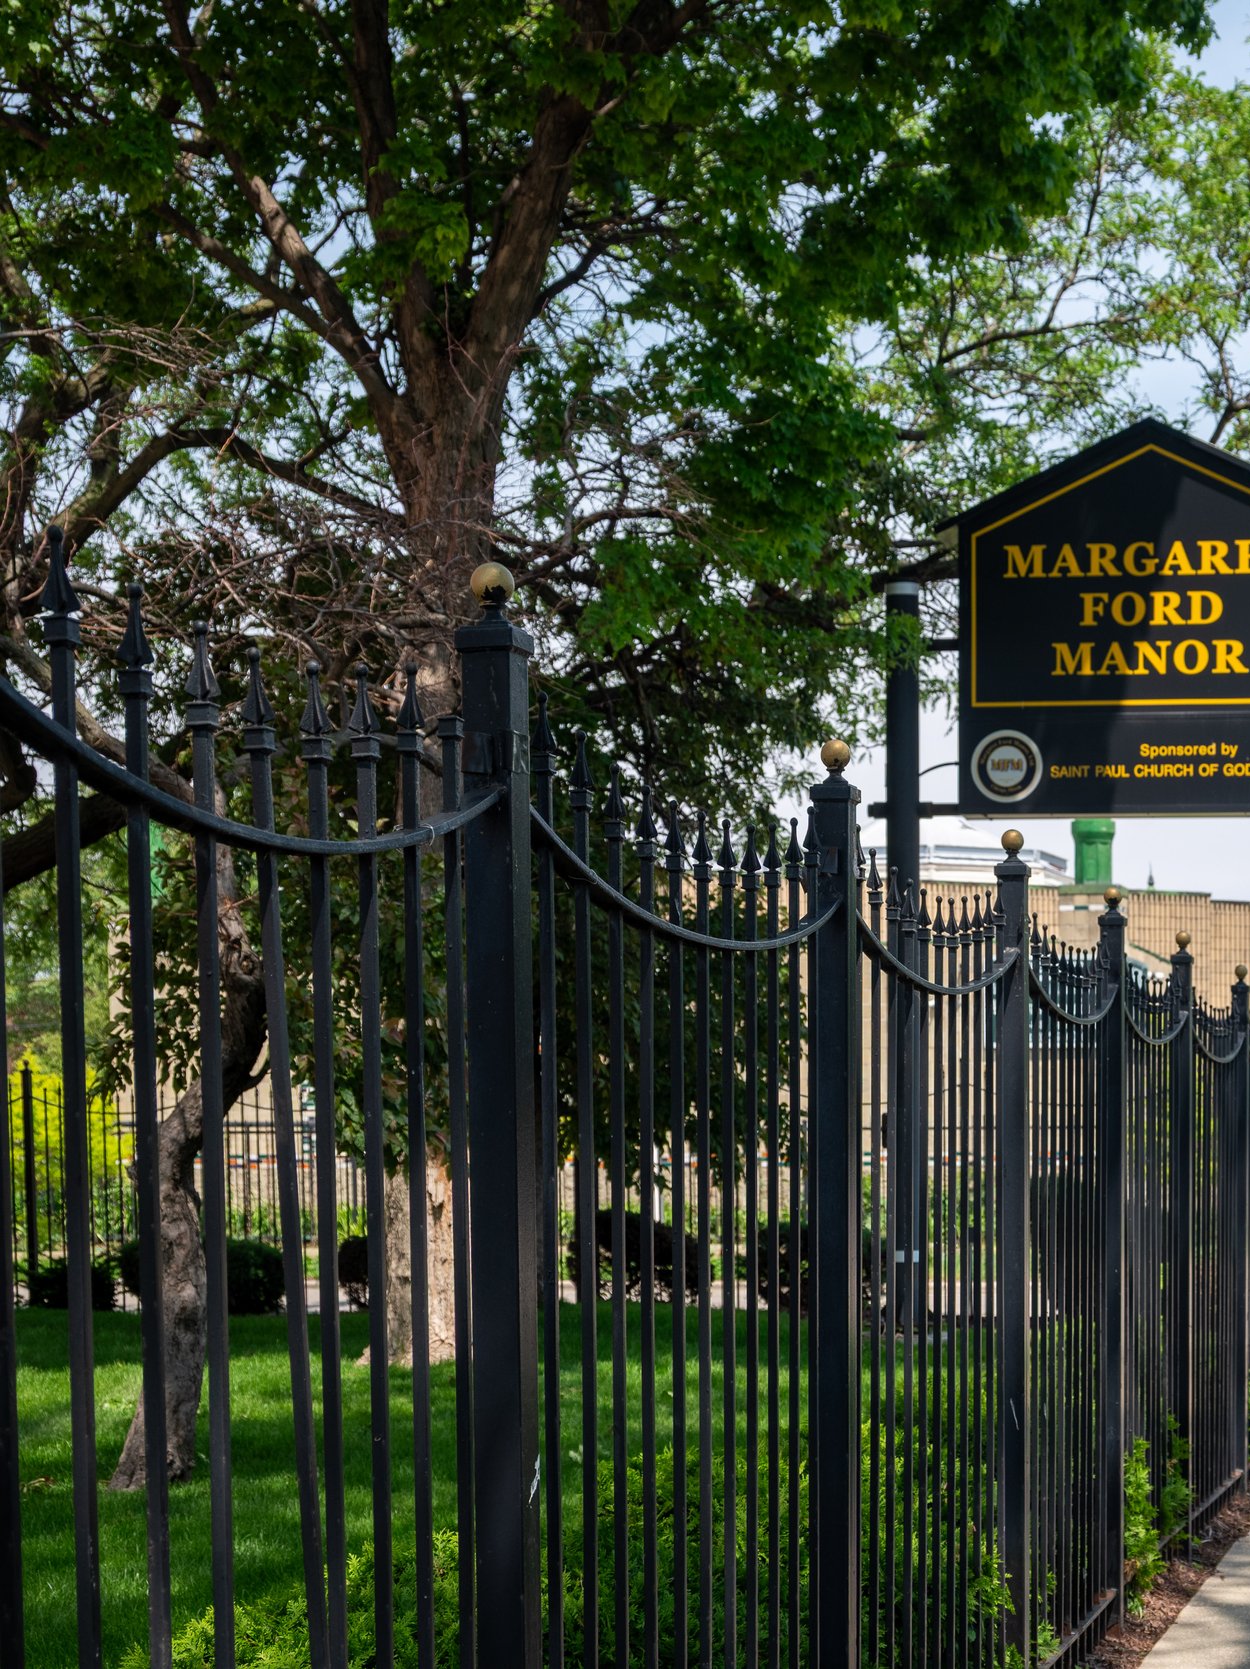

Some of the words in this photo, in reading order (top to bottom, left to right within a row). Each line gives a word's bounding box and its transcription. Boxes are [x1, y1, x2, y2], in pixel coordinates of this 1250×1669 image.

[1079, 590, 1224, 627] FORD
[1051, 638, 1250, 677] MANOR
[1139, 742, 1217, 760] Sponsored
[1220, 742, 1239, 758] by
[1050, 764, 1090, 779] SAINT
[1095, 763, 1131, 778] PAUL
[1133, 763, 1195, 778] CHURCH
[1198, 763, 1219, 777] OF
